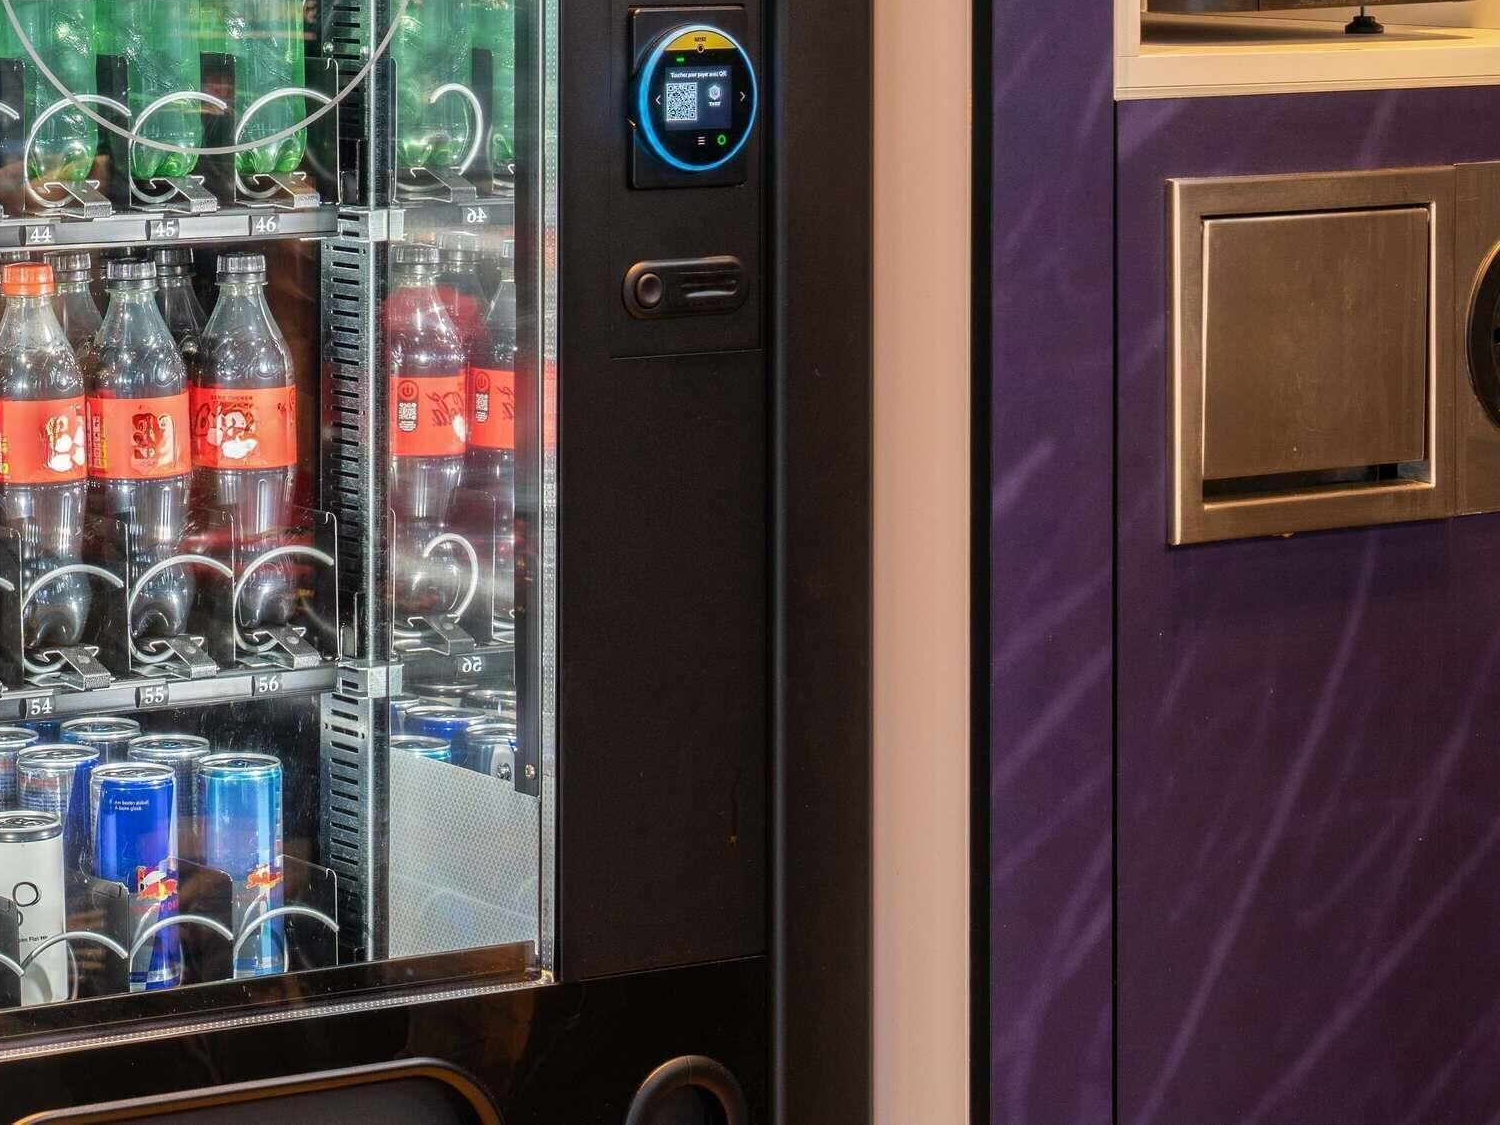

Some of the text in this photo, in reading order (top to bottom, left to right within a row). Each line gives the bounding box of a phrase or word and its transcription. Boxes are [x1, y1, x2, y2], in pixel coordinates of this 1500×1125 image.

[155, 220, 176, 237] 45
[256, 216, 277, 233] 46
[30, 227, 52, 242] 44
[258, 676, 279, 692] 56
[144, 687, 165, 704] 55
[31, 699, 52, 715] 54
